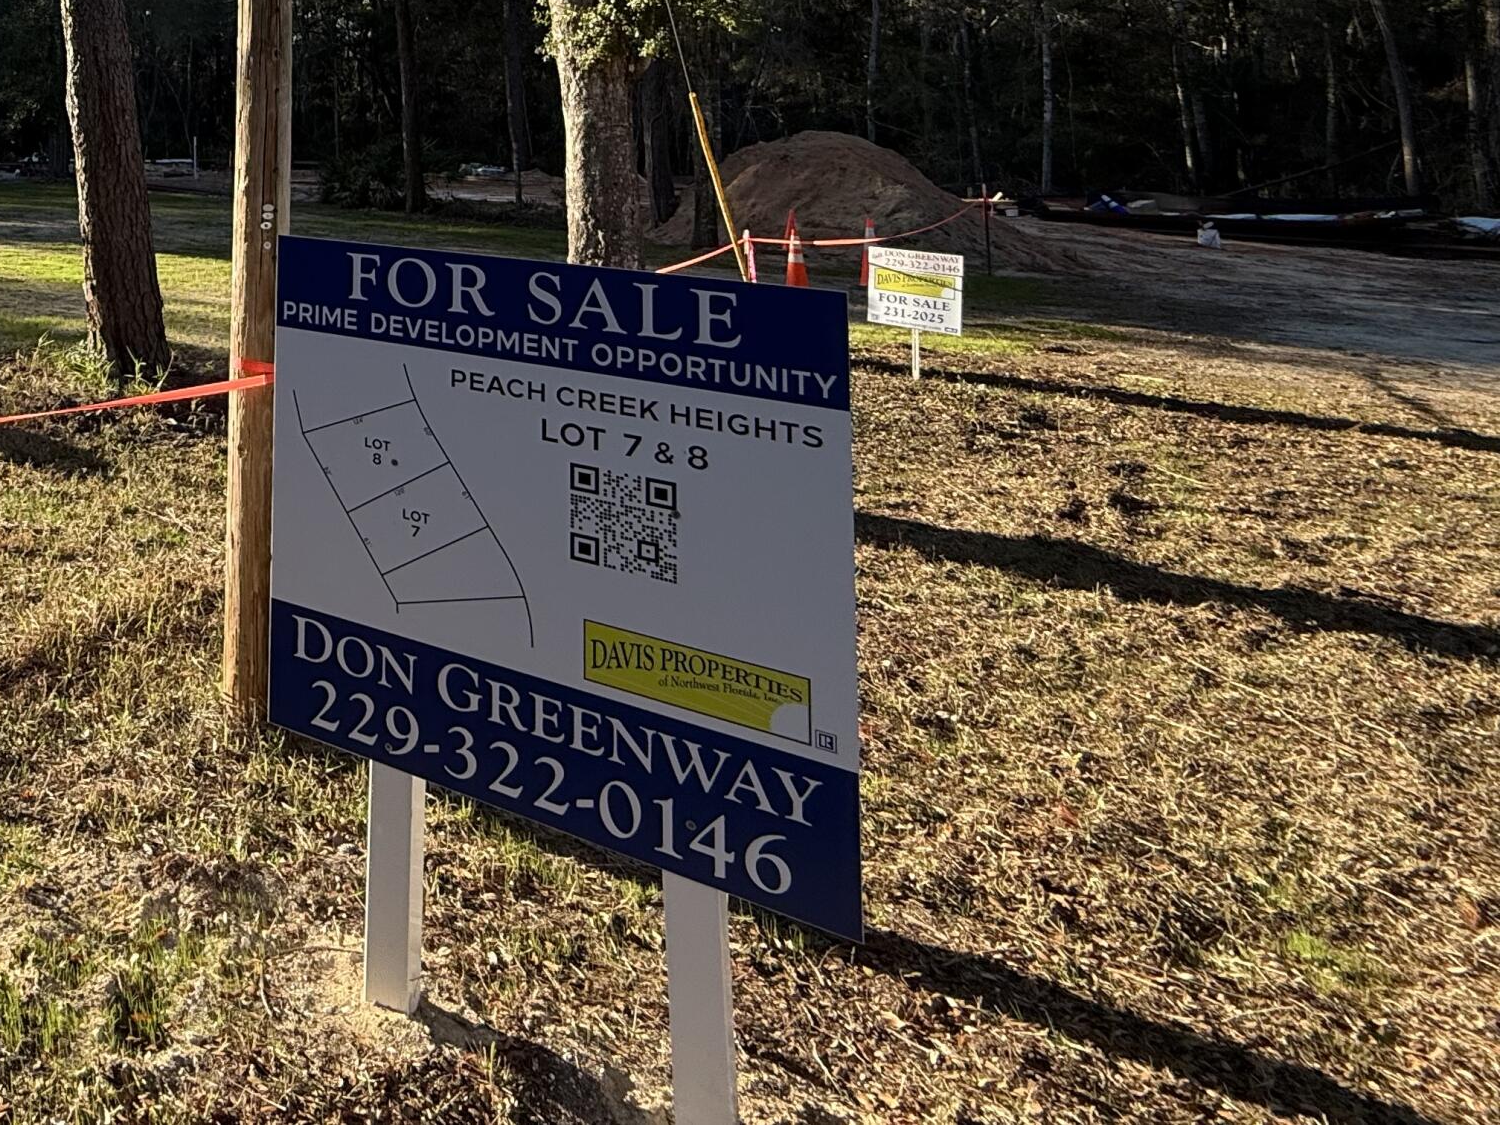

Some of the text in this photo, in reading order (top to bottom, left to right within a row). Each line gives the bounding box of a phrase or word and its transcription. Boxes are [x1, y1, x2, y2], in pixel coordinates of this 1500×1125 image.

[884, 249, 960, 264] DON GREENWAY
[885, 257, 960, 274] 229-322-0146
[877, 273, 901, 286] DAVIS
[346, 251, 742, 349] FOR SALE
[878, 292, 951, 312] FOR SALE
[883, 306, 945, 324] 231-2025
[283, 301, 838, 400] PRIME DEVELOPMENT OPPORTUNITY
[451, 369, 824, 449] PEACH CREEK HEIGHTS
[364, 437, 391, 452] LOT
[541, 418, 709, 470] LOT 7 & 8
[372, 453, 382, 465] 8
[402, 508, 431, 524] LOT
[411, 524, 421, 537] 7
[591, 639, 803, 703] DAVIS PROPERTIES
[658, 675, 669, 687] of
[670, 676, 720, 693] Northwest
[291, 614, 824, 827] DON GREENWAY
[310, 680, 792, 895] 229-322-0146
